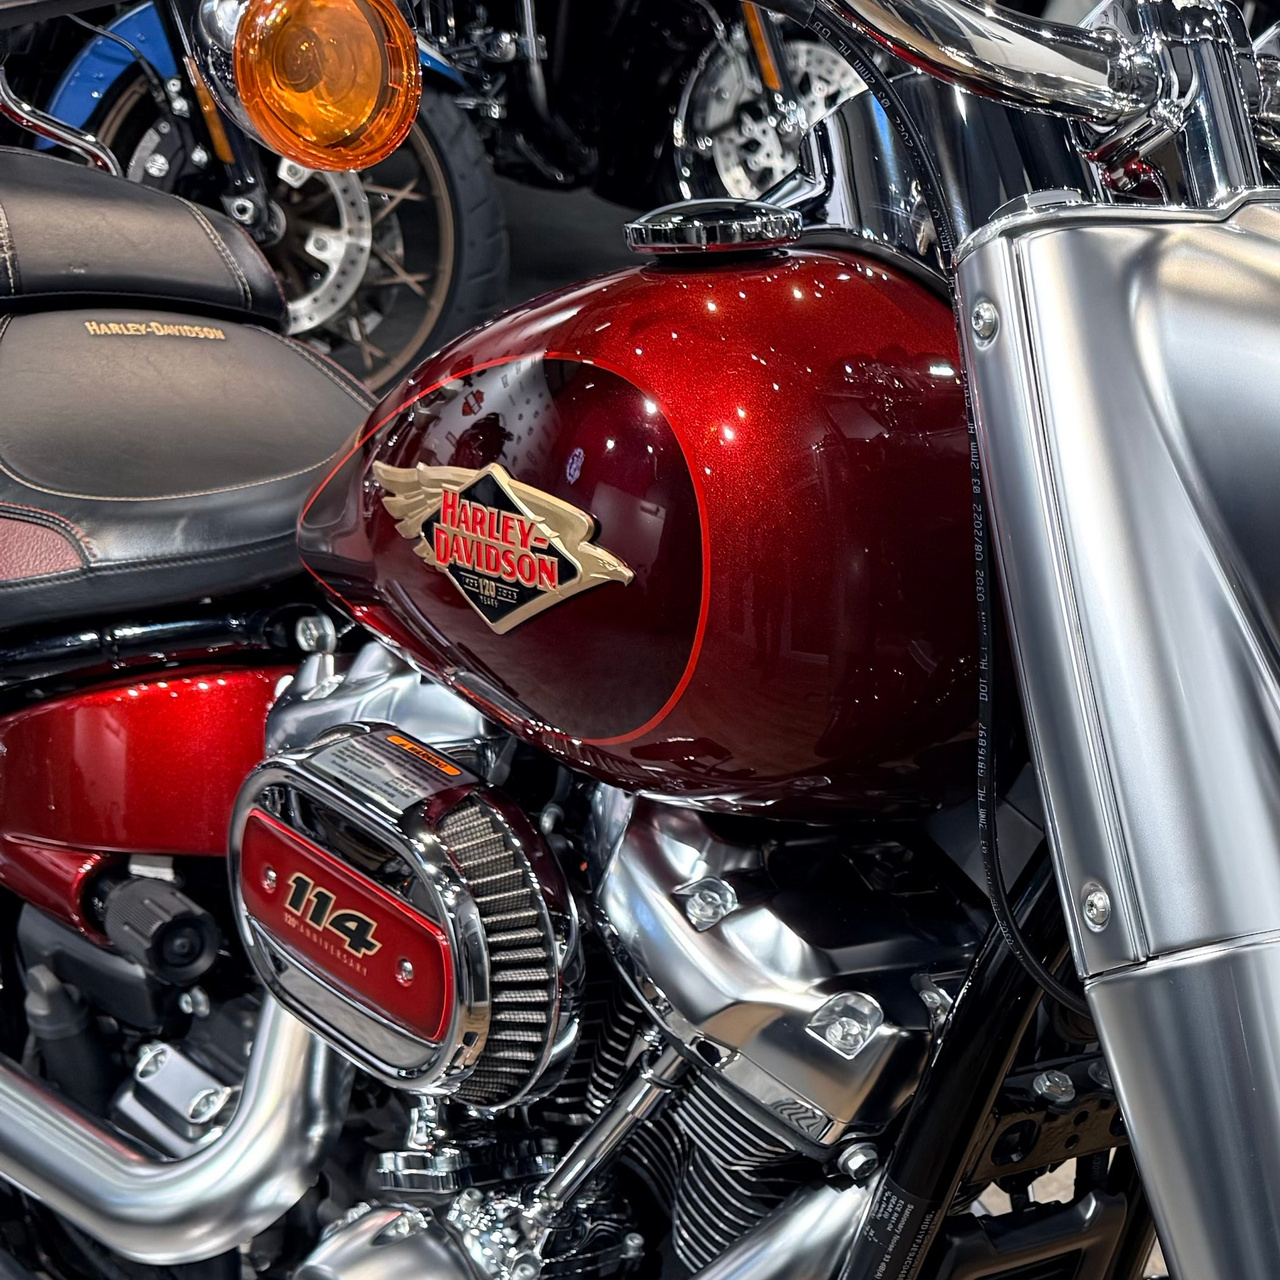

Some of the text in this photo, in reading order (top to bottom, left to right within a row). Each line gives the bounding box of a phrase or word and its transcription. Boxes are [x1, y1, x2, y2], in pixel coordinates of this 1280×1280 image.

[84, 320, 226, 340] HARLEY-DAVIDSON
[973, 503, 984, 561] 08/2022
[434, 523, 558, 590] DAVIDSON
[478, 578, 496, 598] 120
[975, 570, 986, 602] 0302
[979, 678, 989, 701] DOT
[284, 871, 383, 959] 114
[300, 924, 368, 976] ANNIVERSARY
[893, 1202, 914, 1235] Stationary
